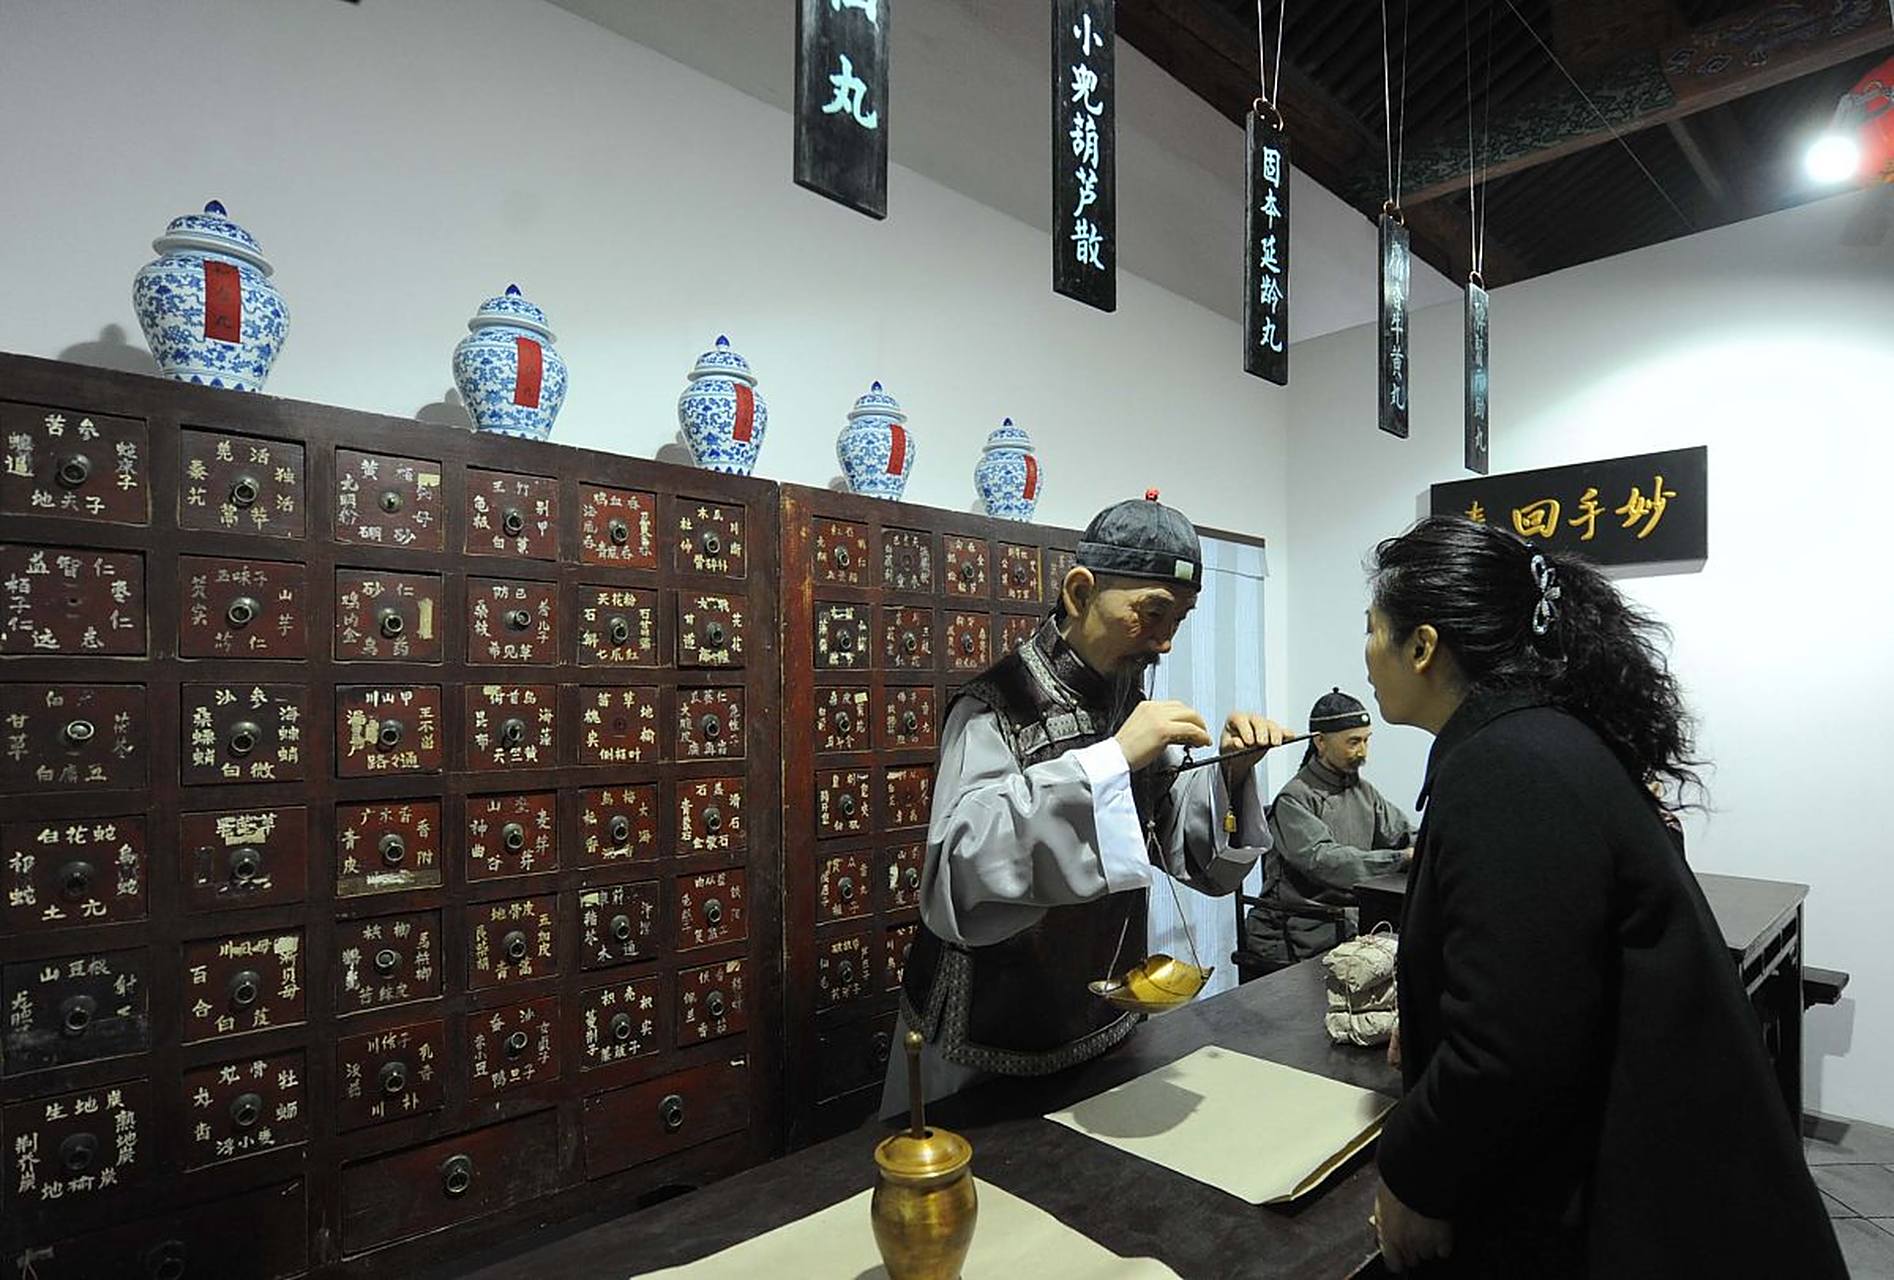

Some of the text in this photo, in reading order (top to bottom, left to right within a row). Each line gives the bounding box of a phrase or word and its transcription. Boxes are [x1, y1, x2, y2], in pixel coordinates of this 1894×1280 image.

[1260, 146, 1284, 353] 固本延龄丸
[26, 551, 115, 579] 益智仁
[362, 581, 415, 598] 砂仁
[365, 690, 413, 708] 川山甲
[5, 713, 30, 761] 甘草
[37, 823, 117, 845] 白花蛇
[417, 819, 434, 866] 香附
[341, 828, 361, 874] 青皮
[41, 899, 107, 920] 土元
[490, 901, 536, 921] 地骨皮
[189, 964, 213, 1018] 百合
